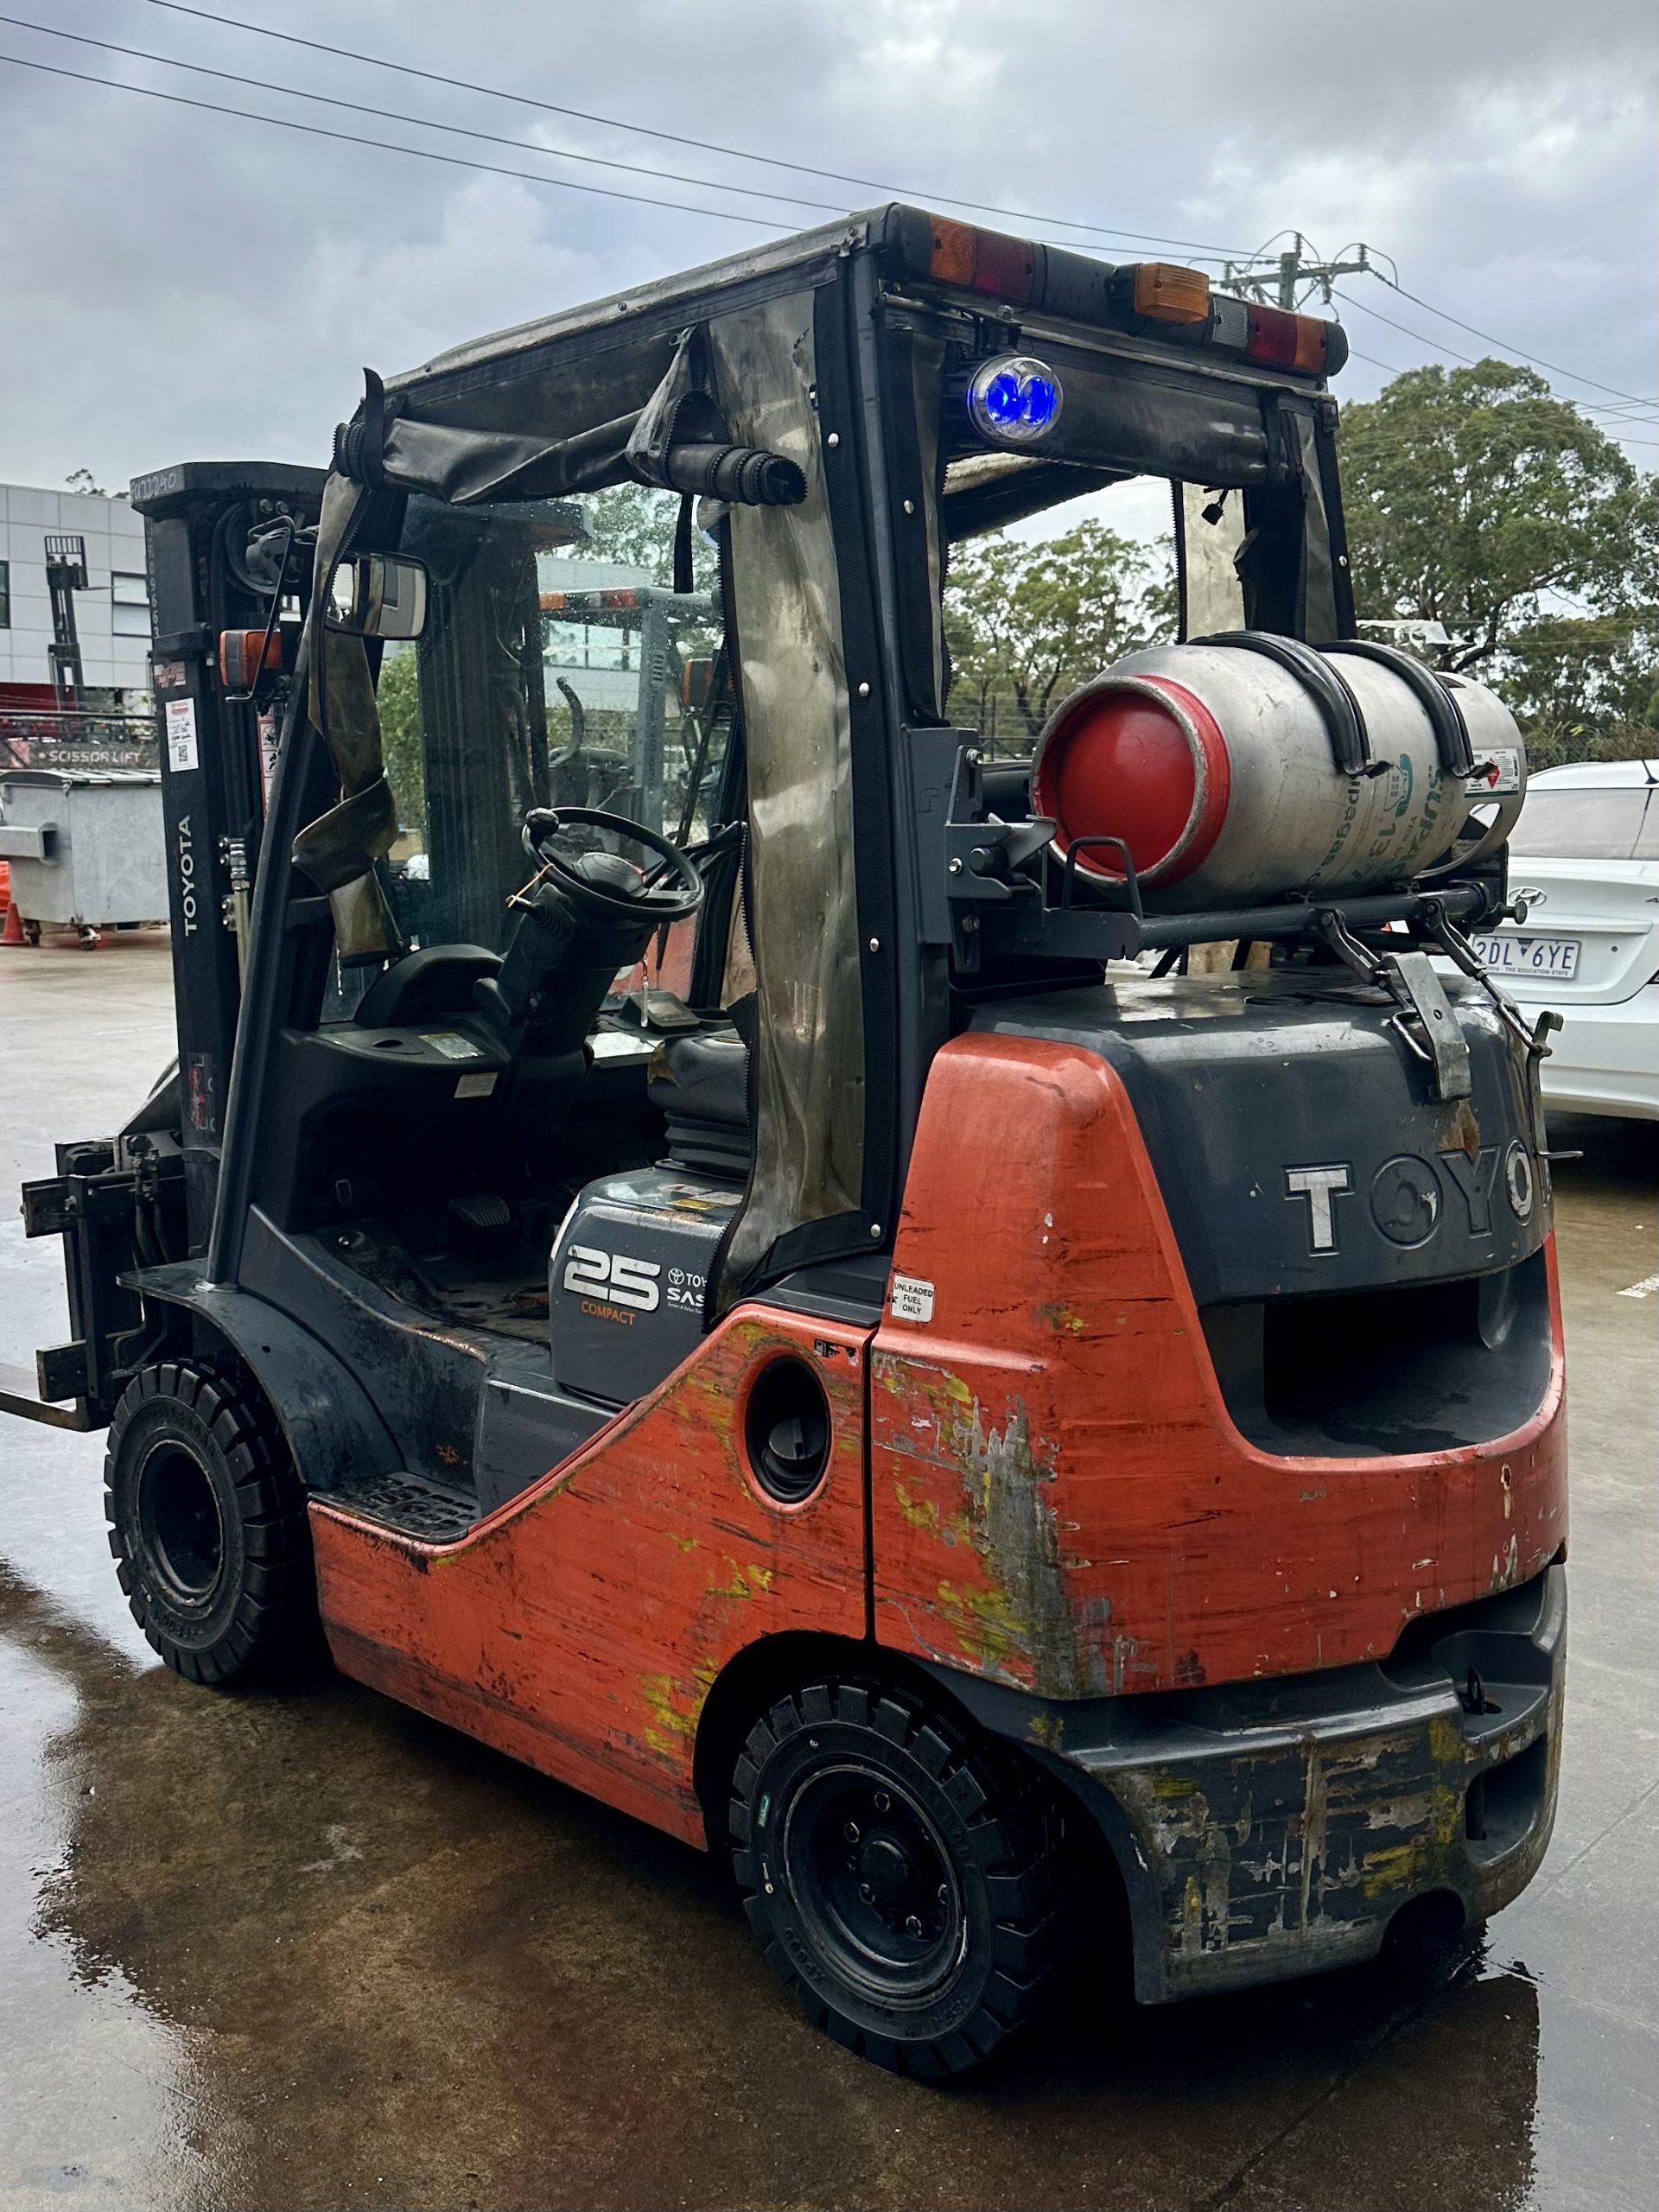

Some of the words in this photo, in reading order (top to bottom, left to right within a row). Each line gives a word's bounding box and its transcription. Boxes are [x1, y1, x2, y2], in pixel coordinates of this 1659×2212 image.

[48, 750, 109, 763] SCISSOR
[112, 752, 141, 764] LIFT
[178, 814, 198, 938] TOYOTA
[1532, 945, 1575, 970] 6YE
[1551, 969, 1569, 977] STATE
[1282, 1136, 1554, 1258] TOYO
[563, 1244, 661, 1312] 25
[685, 1272, 708, 1288] TOY
[894, 1282, 934, 1298] UNLEADED
[903, 1294, 923, 1306] FUEL
[581, 1300, 637, 1326] COMPACT
[902, 1304, 922, 1315] ONLY
